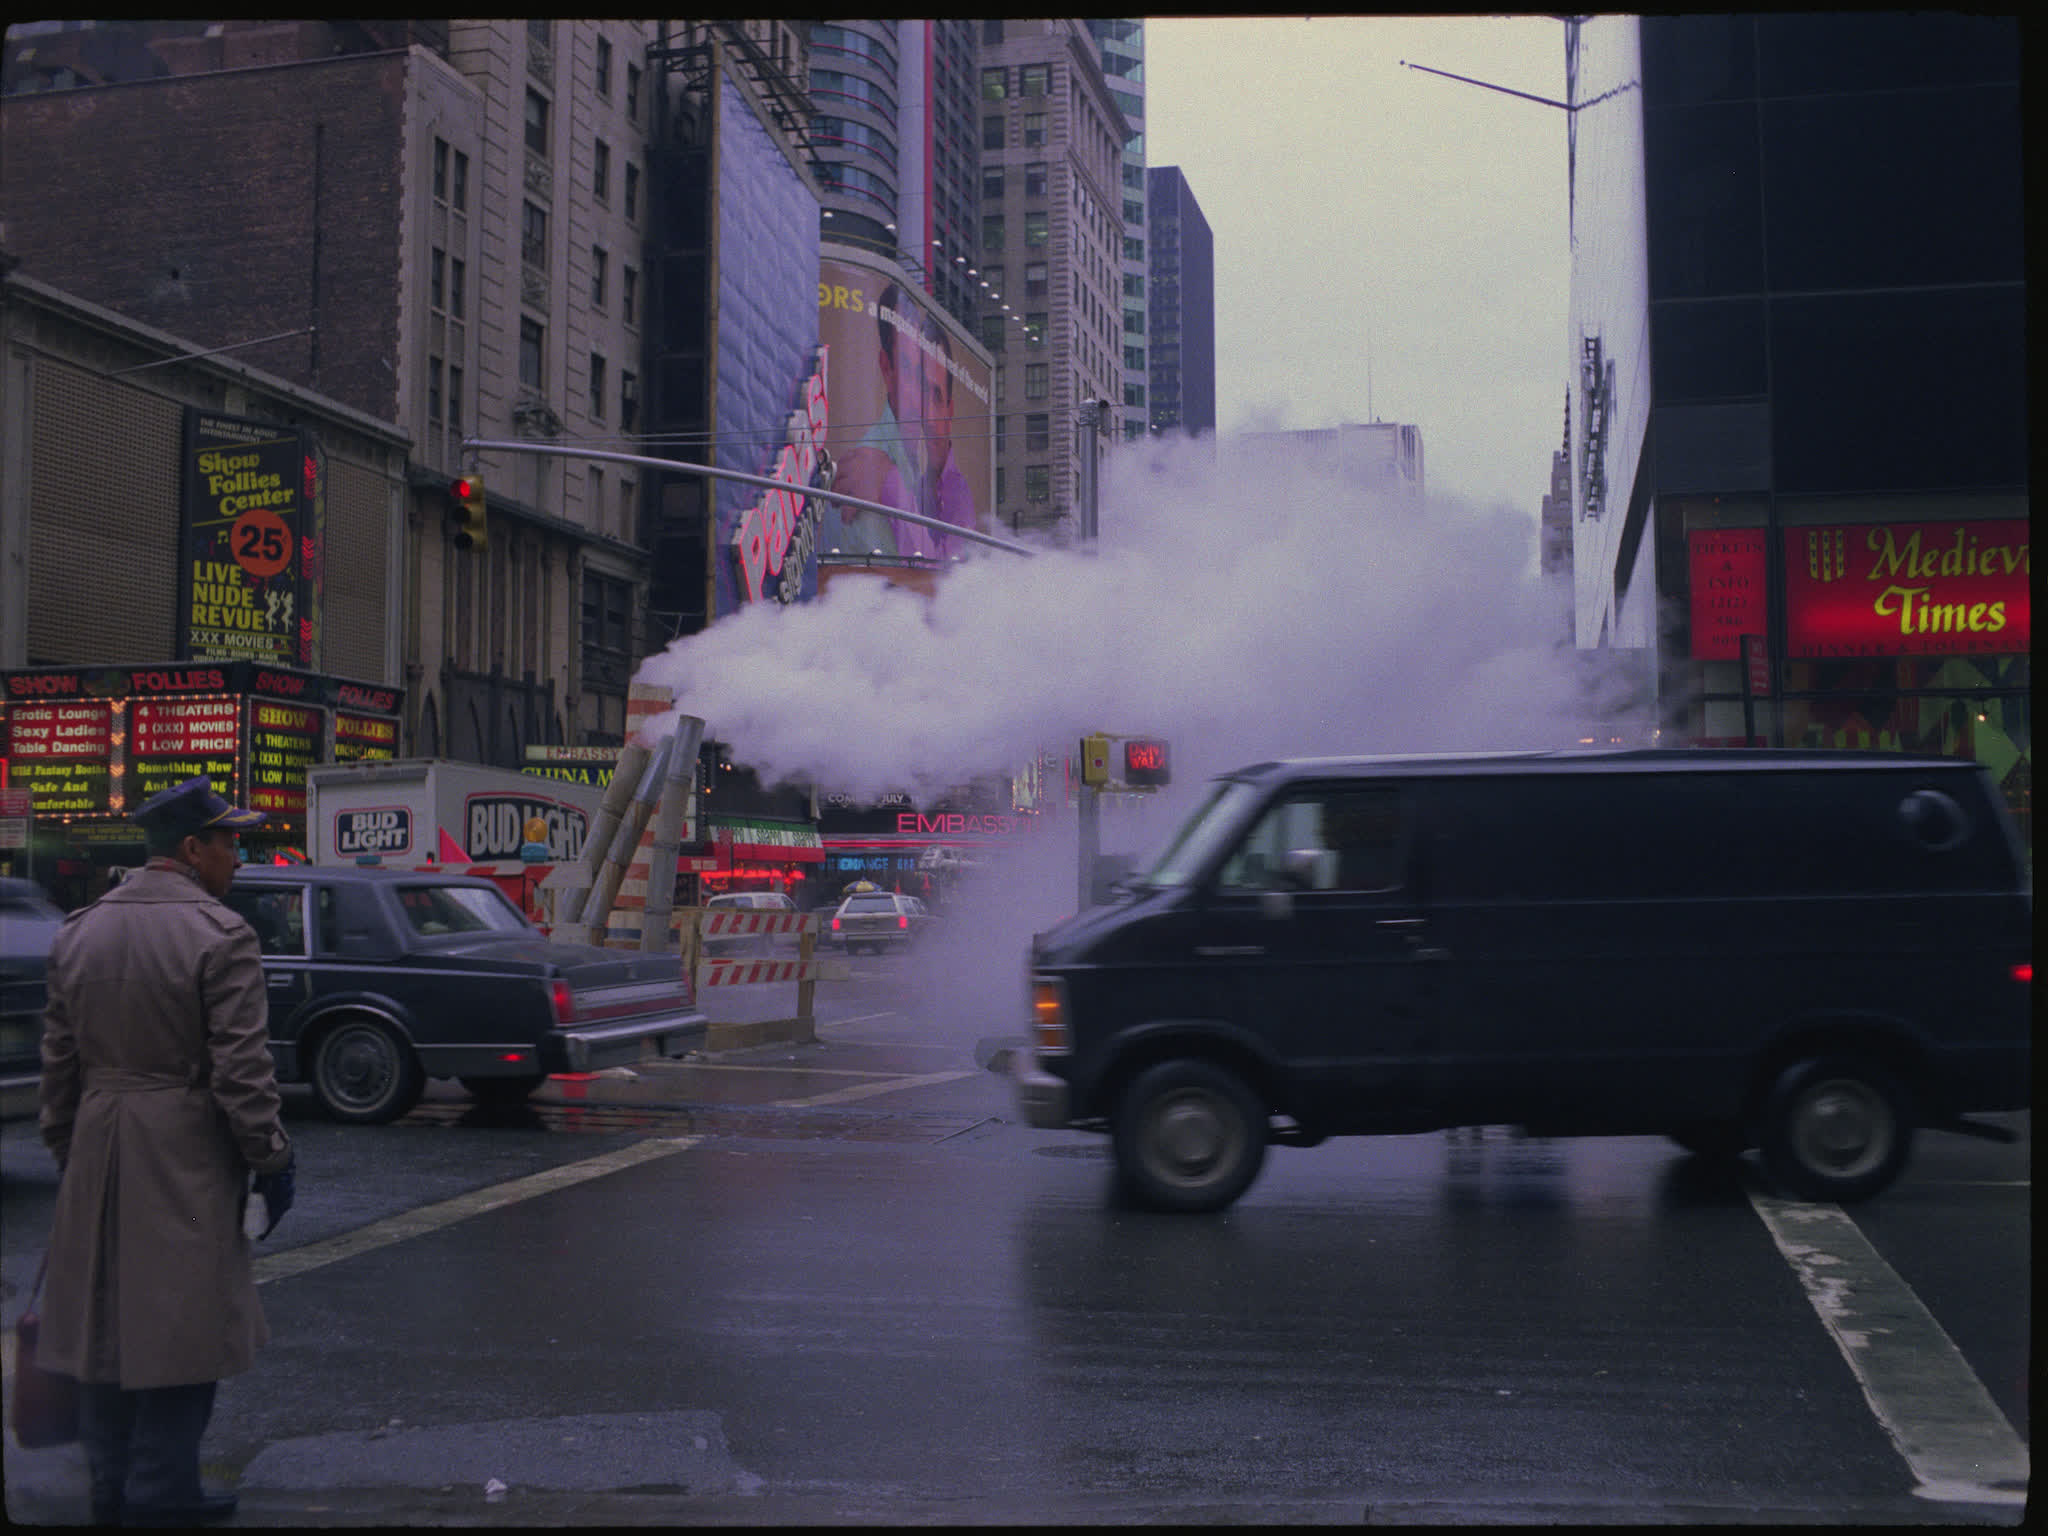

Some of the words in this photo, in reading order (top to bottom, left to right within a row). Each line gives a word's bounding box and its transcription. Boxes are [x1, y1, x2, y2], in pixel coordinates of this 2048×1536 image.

[198, 452, 260, 476] Show
[209, 472, 280, 496] Follies
[220, 488, 295, 516] Center
[194, 560, 241, 585] LIVE
[193, 582, 254, 608] NUDE
[192, 603, 264, 631] REVUE
[1873, 584, 2007, 635] Times
[191, 630, 219, 645] XXX
[225, 634, 274, 649] MOVIES
[9, 675, 78, 695] SHOW
[132, 670, 224, 691] FOLLIES
[256, 672, 304, 694] SHOW
[337, 685, 395, 709] FOLLIES
[13, 708, 53, 720] Erotic
[58, 708, 106, 721] Lounge
[138, 706, 149, 717] 4
[156, 703, 234, 716] THEATERS
[258, 706, 308, 729] SHOW
[13, 725, 49, 739] Sexy
[56, 725, 105, 736] Ladies
[138, 722, 147, 734] 8
[152, 721, 184, 735] (XXX)
[189, 720, 234, 733] MOVIES
[13, 742, 47, 753] Table
[52, 741, 105, 754] Dancing
[139, 740, 145, 752] 1
[152, 740, 184, 751] LOW
[190, 738, 234, 750] PRICE
[546, 747, 618, 760] EMBASSY
[34, 764, 72, 778] Fantasy
[137, 761, 201, 776] Something
[207, 760, 232, 773] New
[262, 769, 282, 784] LOW
[285, 772, 305, 784] PRIC
[30, 781, 58, 792] Safe
[62, 781, 88, 792] And
[144, 779, 168, 791] And
[32, 798, 95, 810] mfortable
[288, 796, 306, 808] HOU
[352, 812, 398, 832] BUD
[341, 828, 406, 849] LIGHT
[470, 802, 521, 857] BUD
[523, 805, 585, 862] GHT
